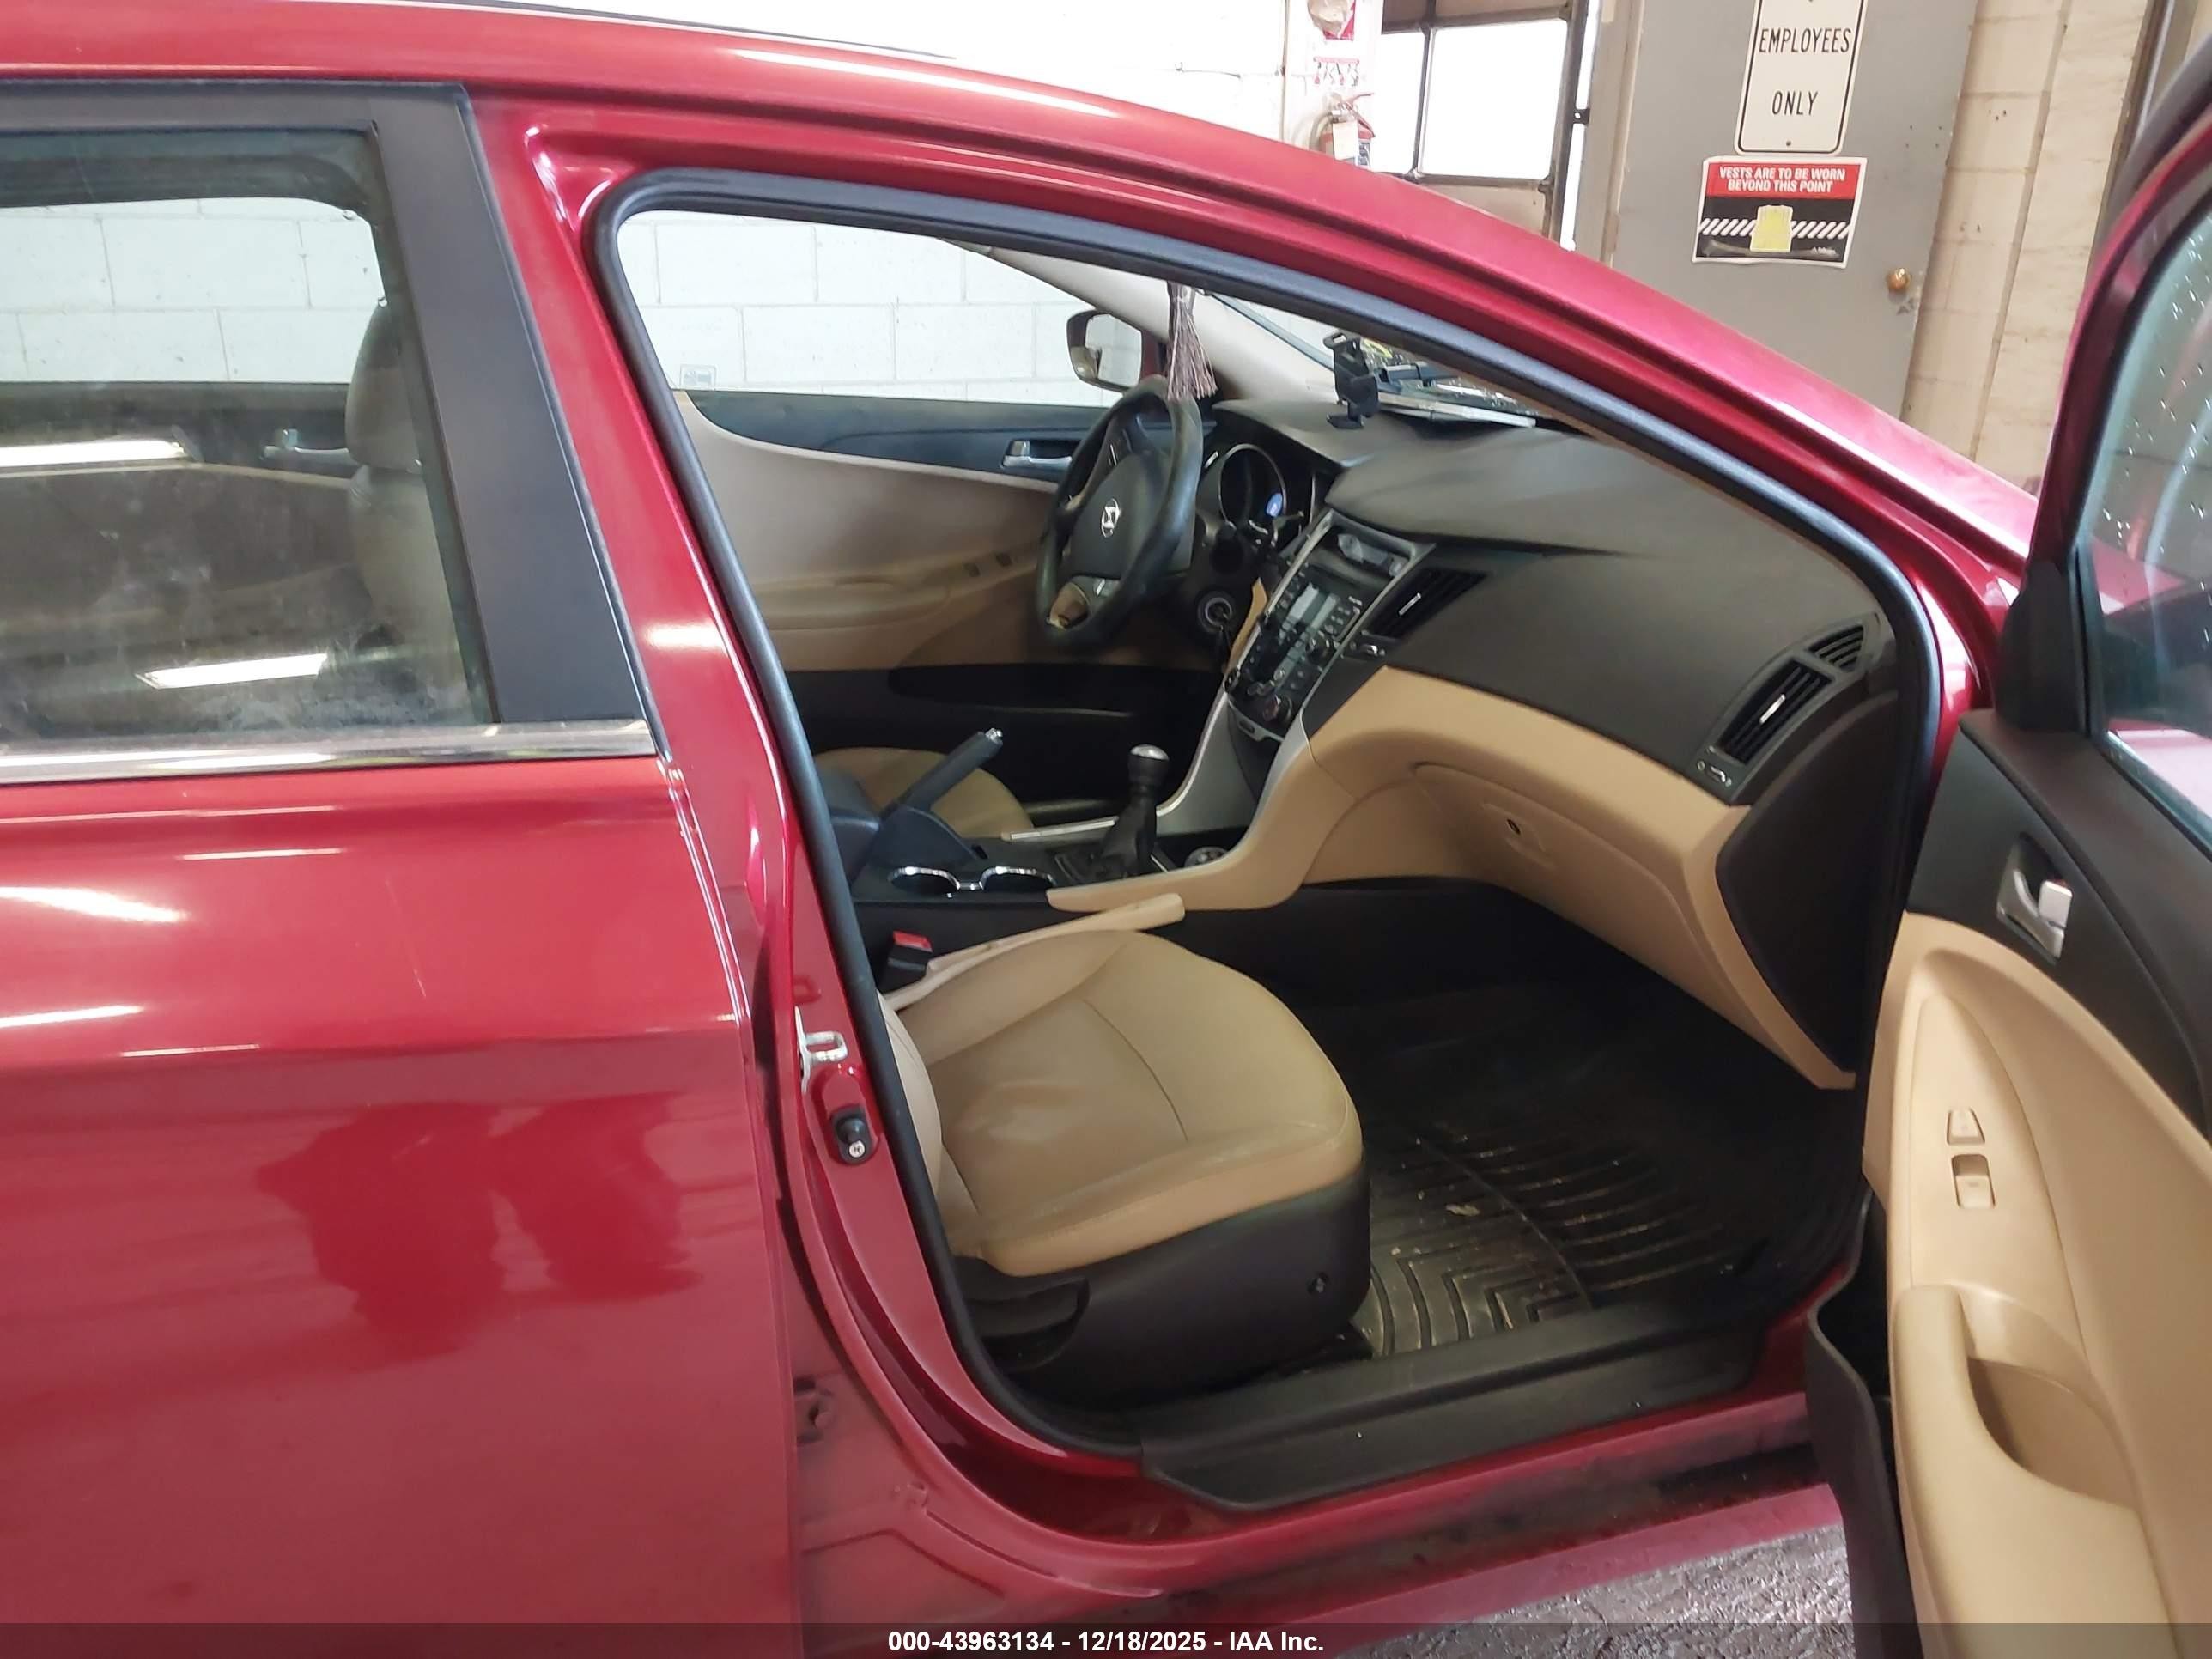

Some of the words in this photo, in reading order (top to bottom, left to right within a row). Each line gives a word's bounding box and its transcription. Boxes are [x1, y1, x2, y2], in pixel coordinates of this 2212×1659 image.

[1759, 28, 1851, 52] EMPLOYEES
[1772, 91, 1818, 115] ONLY
[1719, 167, 1753, 179] VESTS
[1754, 167, 1775, 179] ARE
[1778, 167, 1792, 179] TO
[1794, 168, 1809, 180] BE
[1811, 168, 1846, 181] WORN
[1728, 179, 1771, 191] BEYOND
[1774, 180, 1797, 192] THIS
[1799, 180, 1833, 193] POINT
